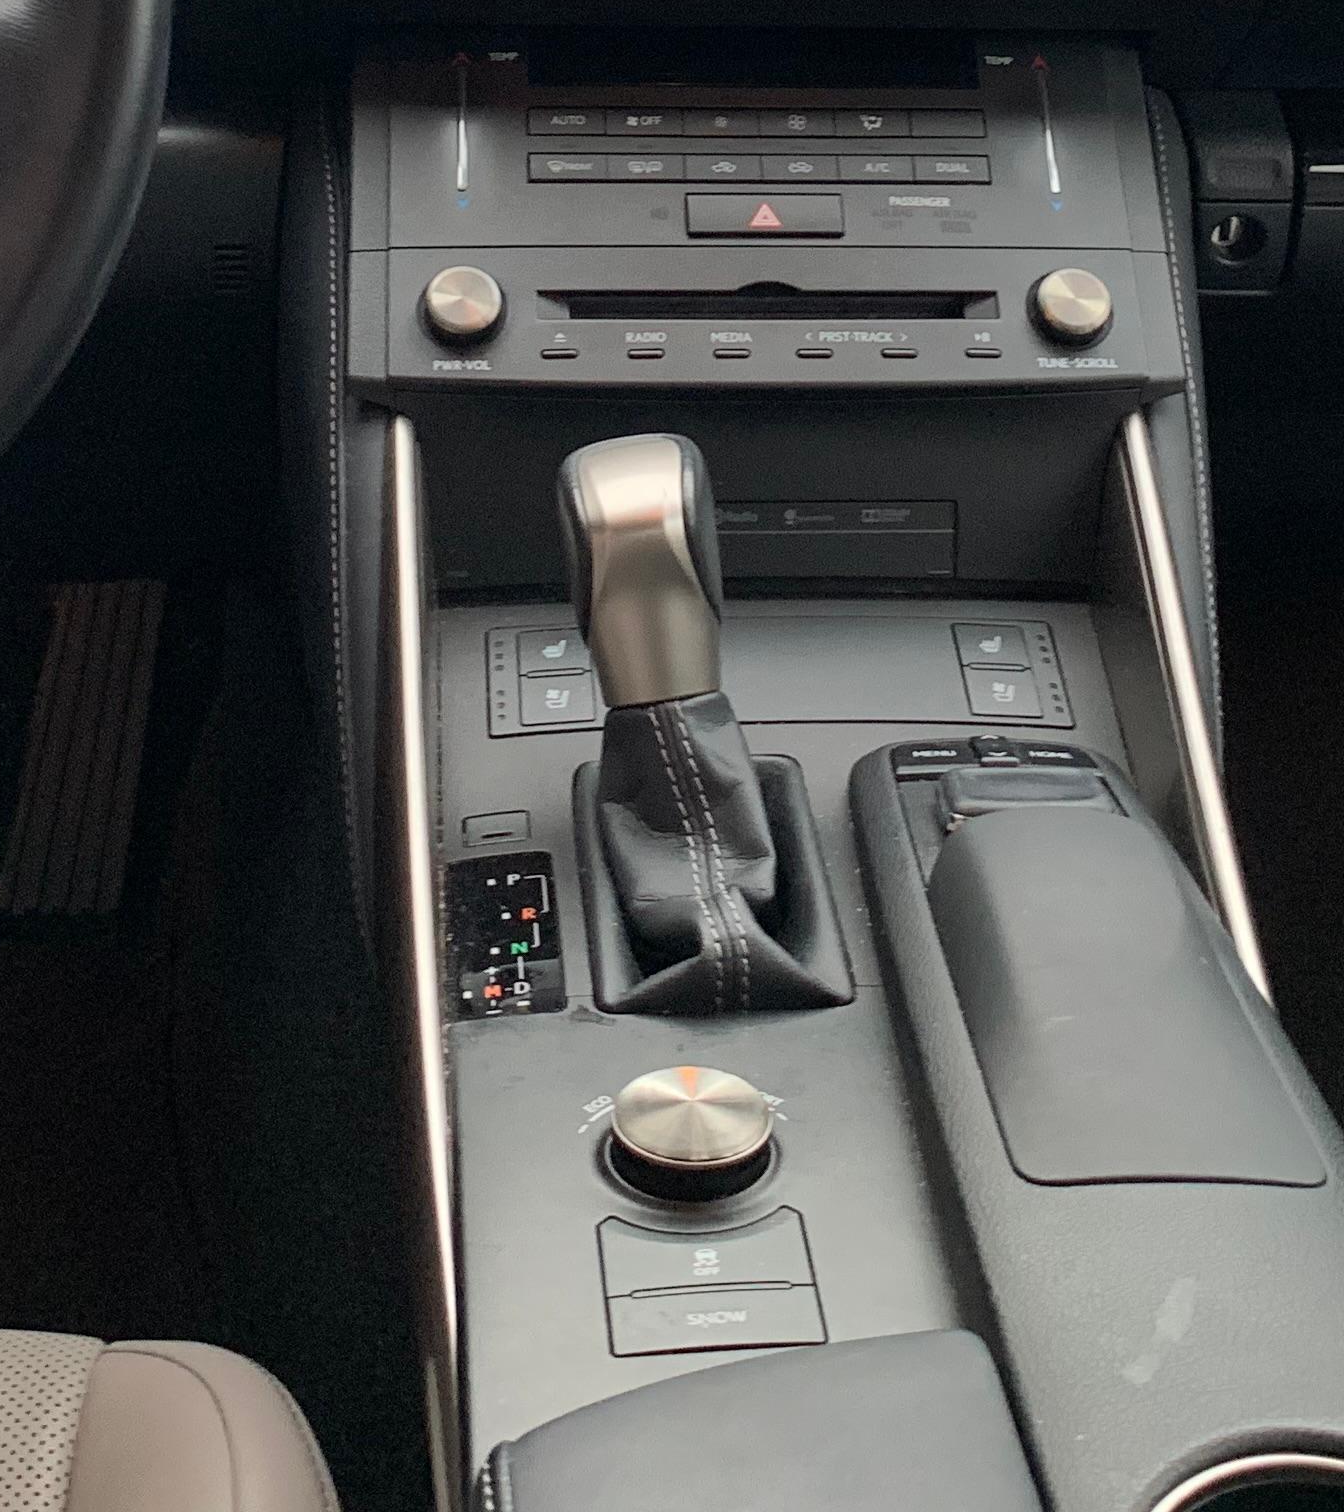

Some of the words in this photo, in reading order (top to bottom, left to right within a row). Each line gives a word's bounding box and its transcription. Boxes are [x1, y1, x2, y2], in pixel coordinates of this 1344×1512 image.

[550, 114, 586, 125] AUTO
[639, 115, 663, 125] OFF
[863, 162, 890, 172] A/C
[935, 161, 970, 173] DUAL
[888, 196, 951, 207] PASSENGER
[624, 332, 667, 343] RADIO
[710, 332, 753, 343] MEDIA
[911, 749, 957, 758] MENU
[1028, 750, 1074, 759] HOME
[507, 873, 521, 886] P
[520, 907, 538, 919] R
[510, 941, 529, 955] N
[513, 981, 532, 995] D
[581, 1094, 614, 1113] ECO
[693, 1266, 721, 1277] OFF
[687, 1310, 746, 1326] SNOW
